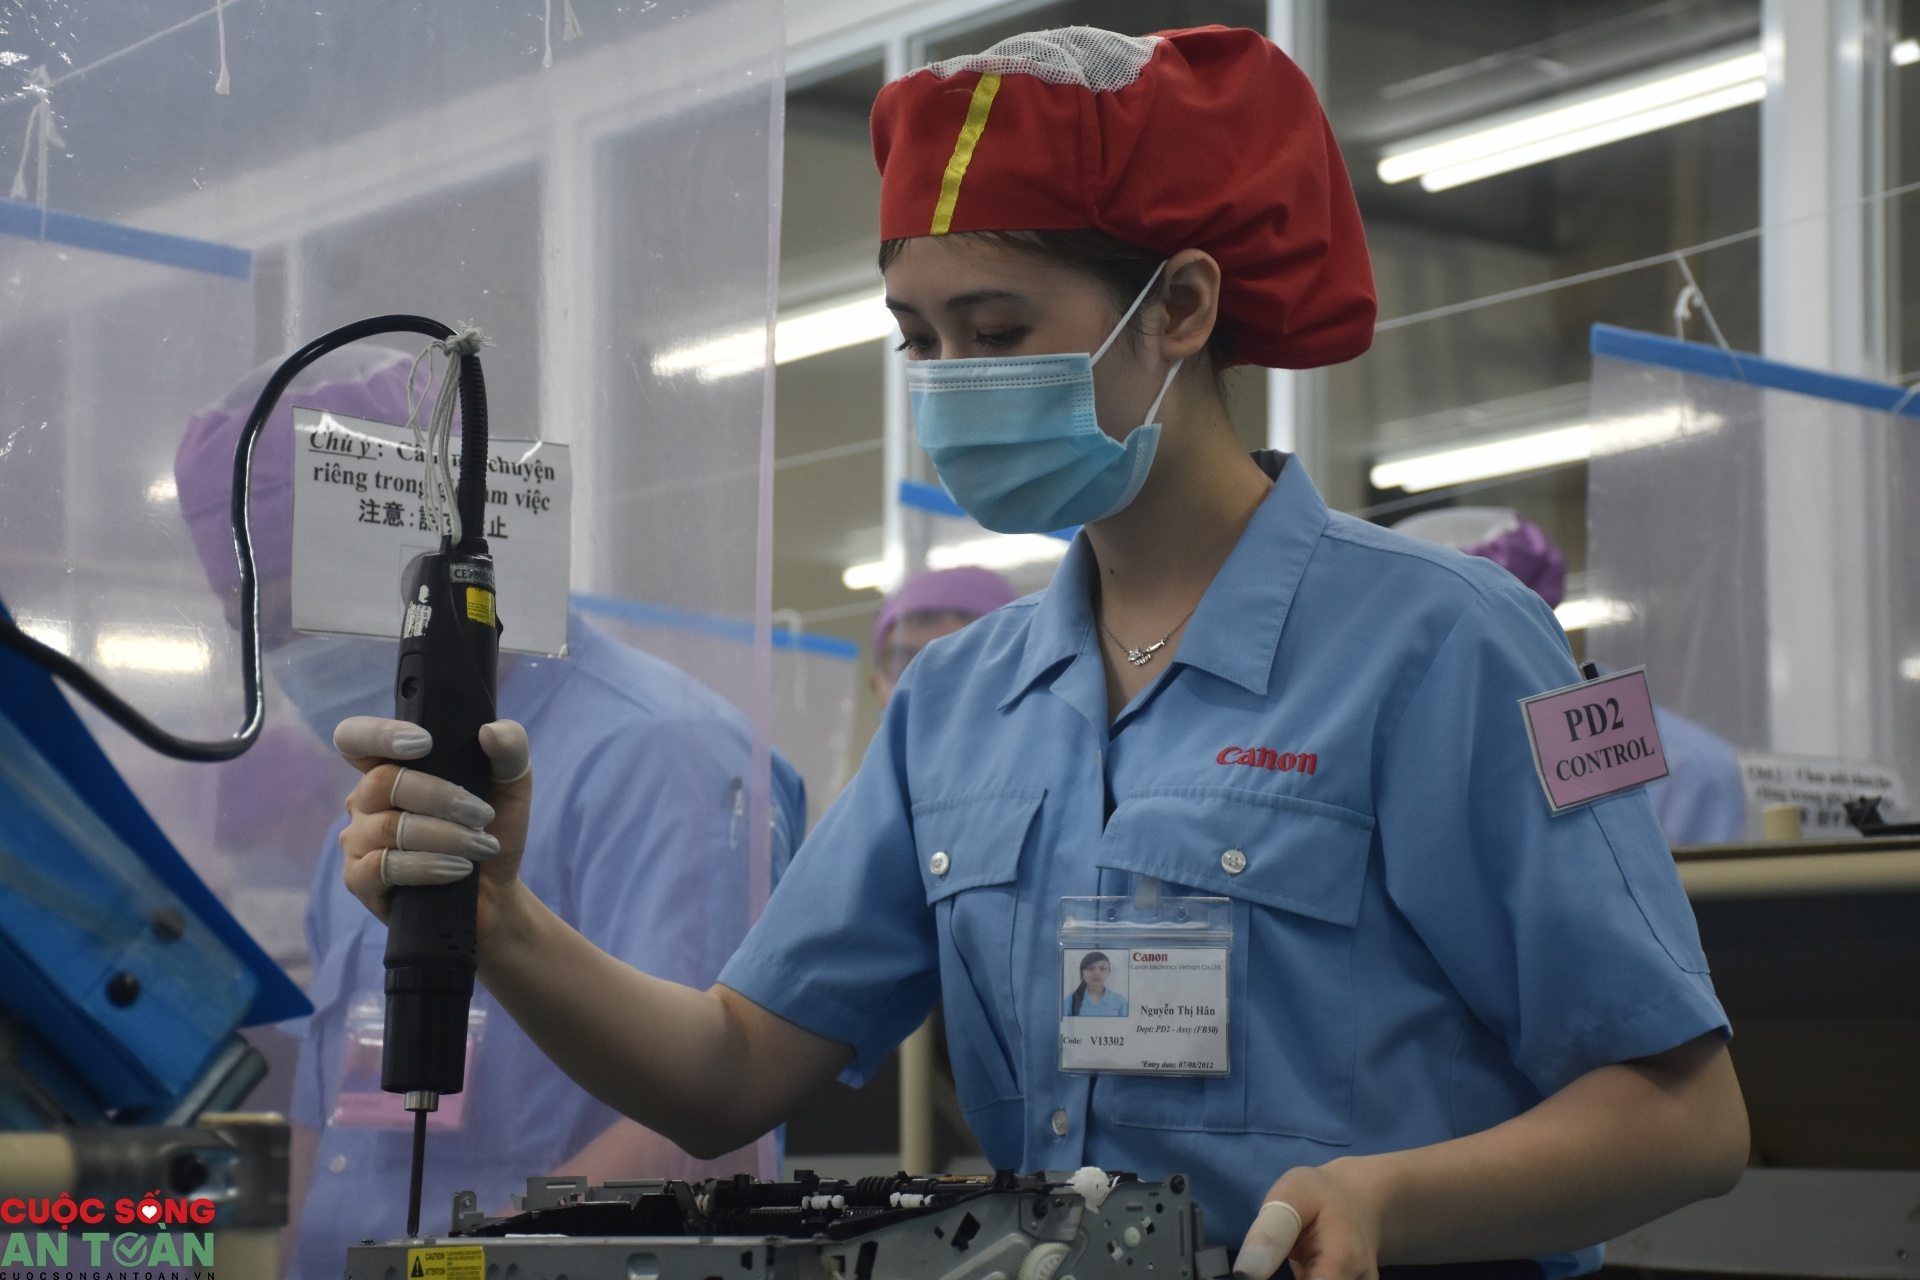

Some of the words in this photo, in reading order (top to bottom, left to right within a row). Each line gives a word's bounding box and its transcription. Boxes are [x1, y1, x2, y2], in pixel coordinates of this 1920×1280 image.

[488, 456, 555, 484] chuyện
[313, 462, 368, 493] riêng
[515, 489, 551, 515] việc
[1563, 697, 1624, 742] PD2
[1216, 746, 1318, 775] Canon
[1556, 736, 1655, 781] CONTROL
[1132, 951, 1168, 963] Canon
[1141, 1004, 1175, 1018] Nguyễn
[1176, 1005, 1194, 1018] Thị
[1196, 1005, 1216, 1016] Hân
[1136, 1025, 1154, 1034] Dept:
[1155, 1025, 1171, 1033] PD2
[1176, 1025, 1193, 1035] Assy
[1063, 1037, 1083, 1045] Code:
[1090, 1036, 1124, 1047] V13302
[1161, 1061, 1177, 1069] date:
[426, 1253, 444, 1261] CAUTION
